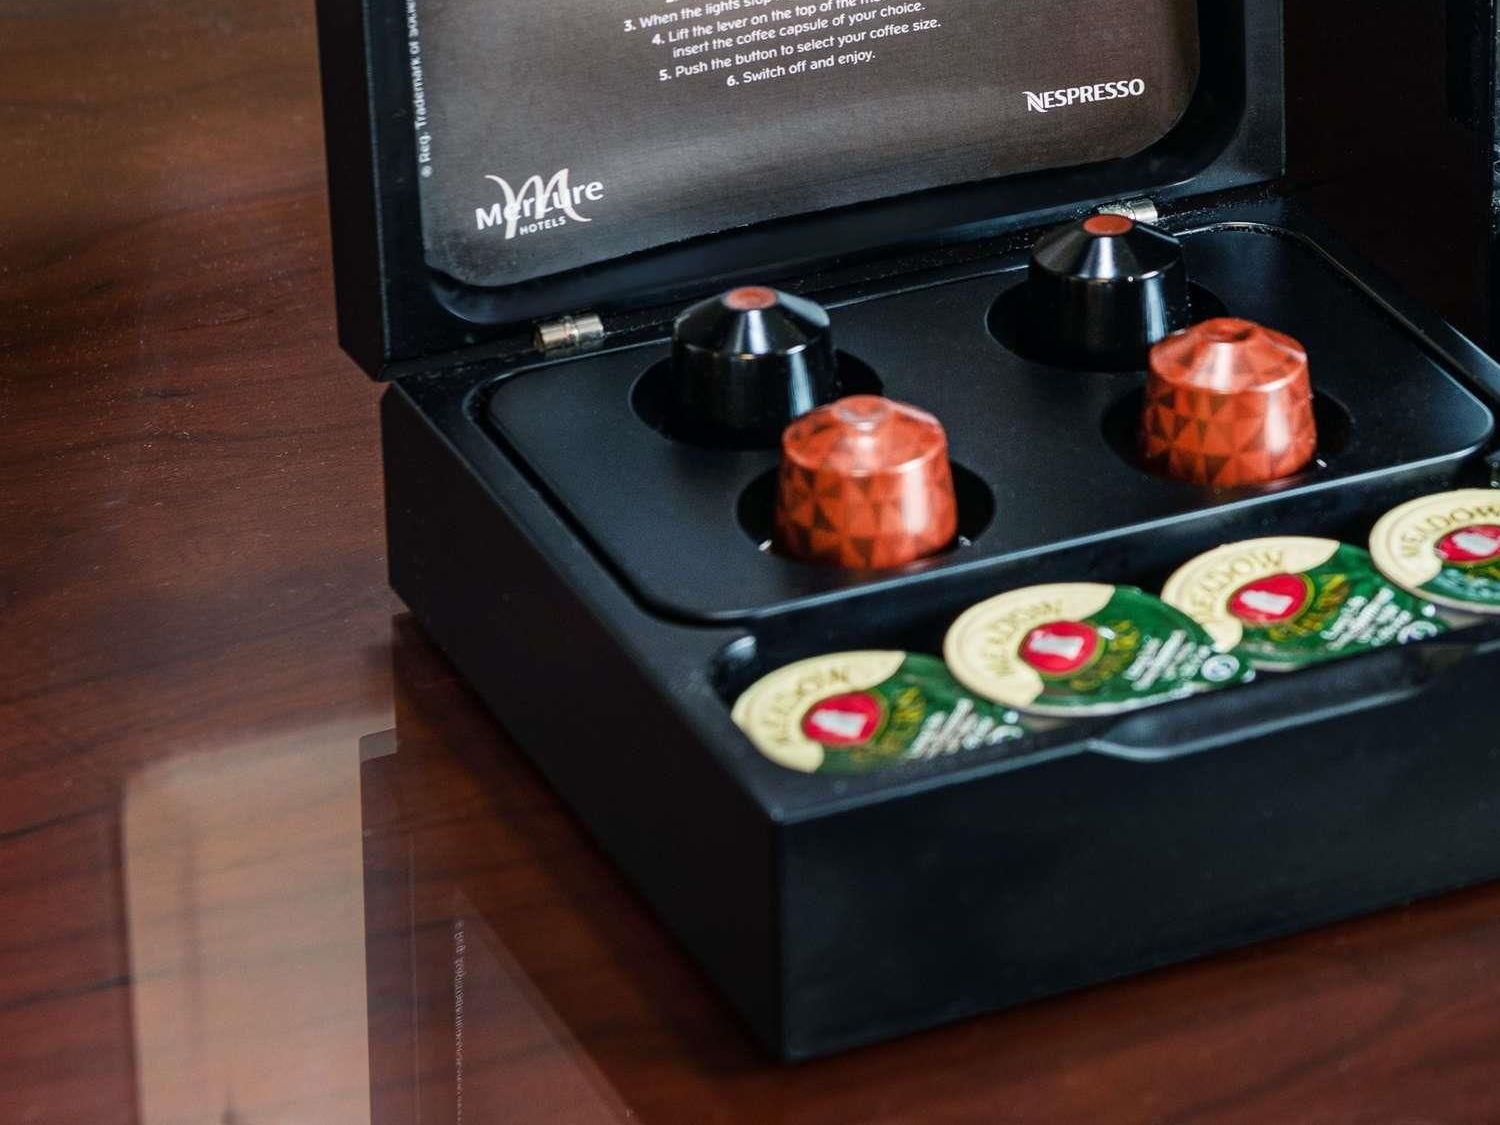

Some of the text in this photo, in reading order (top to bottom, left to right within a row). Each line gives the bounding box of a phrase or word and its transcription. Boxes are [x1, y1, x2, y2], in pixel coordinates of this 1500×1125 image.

[623, 18, 636, 32] 3.
[638, 12, 678, 28] When
[680, 6, 702, 19] the
[651, 33, 665, 45] 4.
[668, 27, 689, 42] Lift
[692, 24, 713, 37] the
[716, 17, 748, 31] lever
[750, 14, 768, 25] on
[770, 9, 792, 21] the
[794, 4, 816, 16] top
[672, 1, 925, 58] insert the coffee capsule of your choice.
[658, 18, 941, 80] 5. Push the button to select your coffee size.
[726, 50, 875, 86] 6. Switch off and enjoy.
[411, 56, 428, 131] Trademark
[1022, 78, 1146, 113] NESPRESSO
[519, 215, 567, 236] HOTELS
